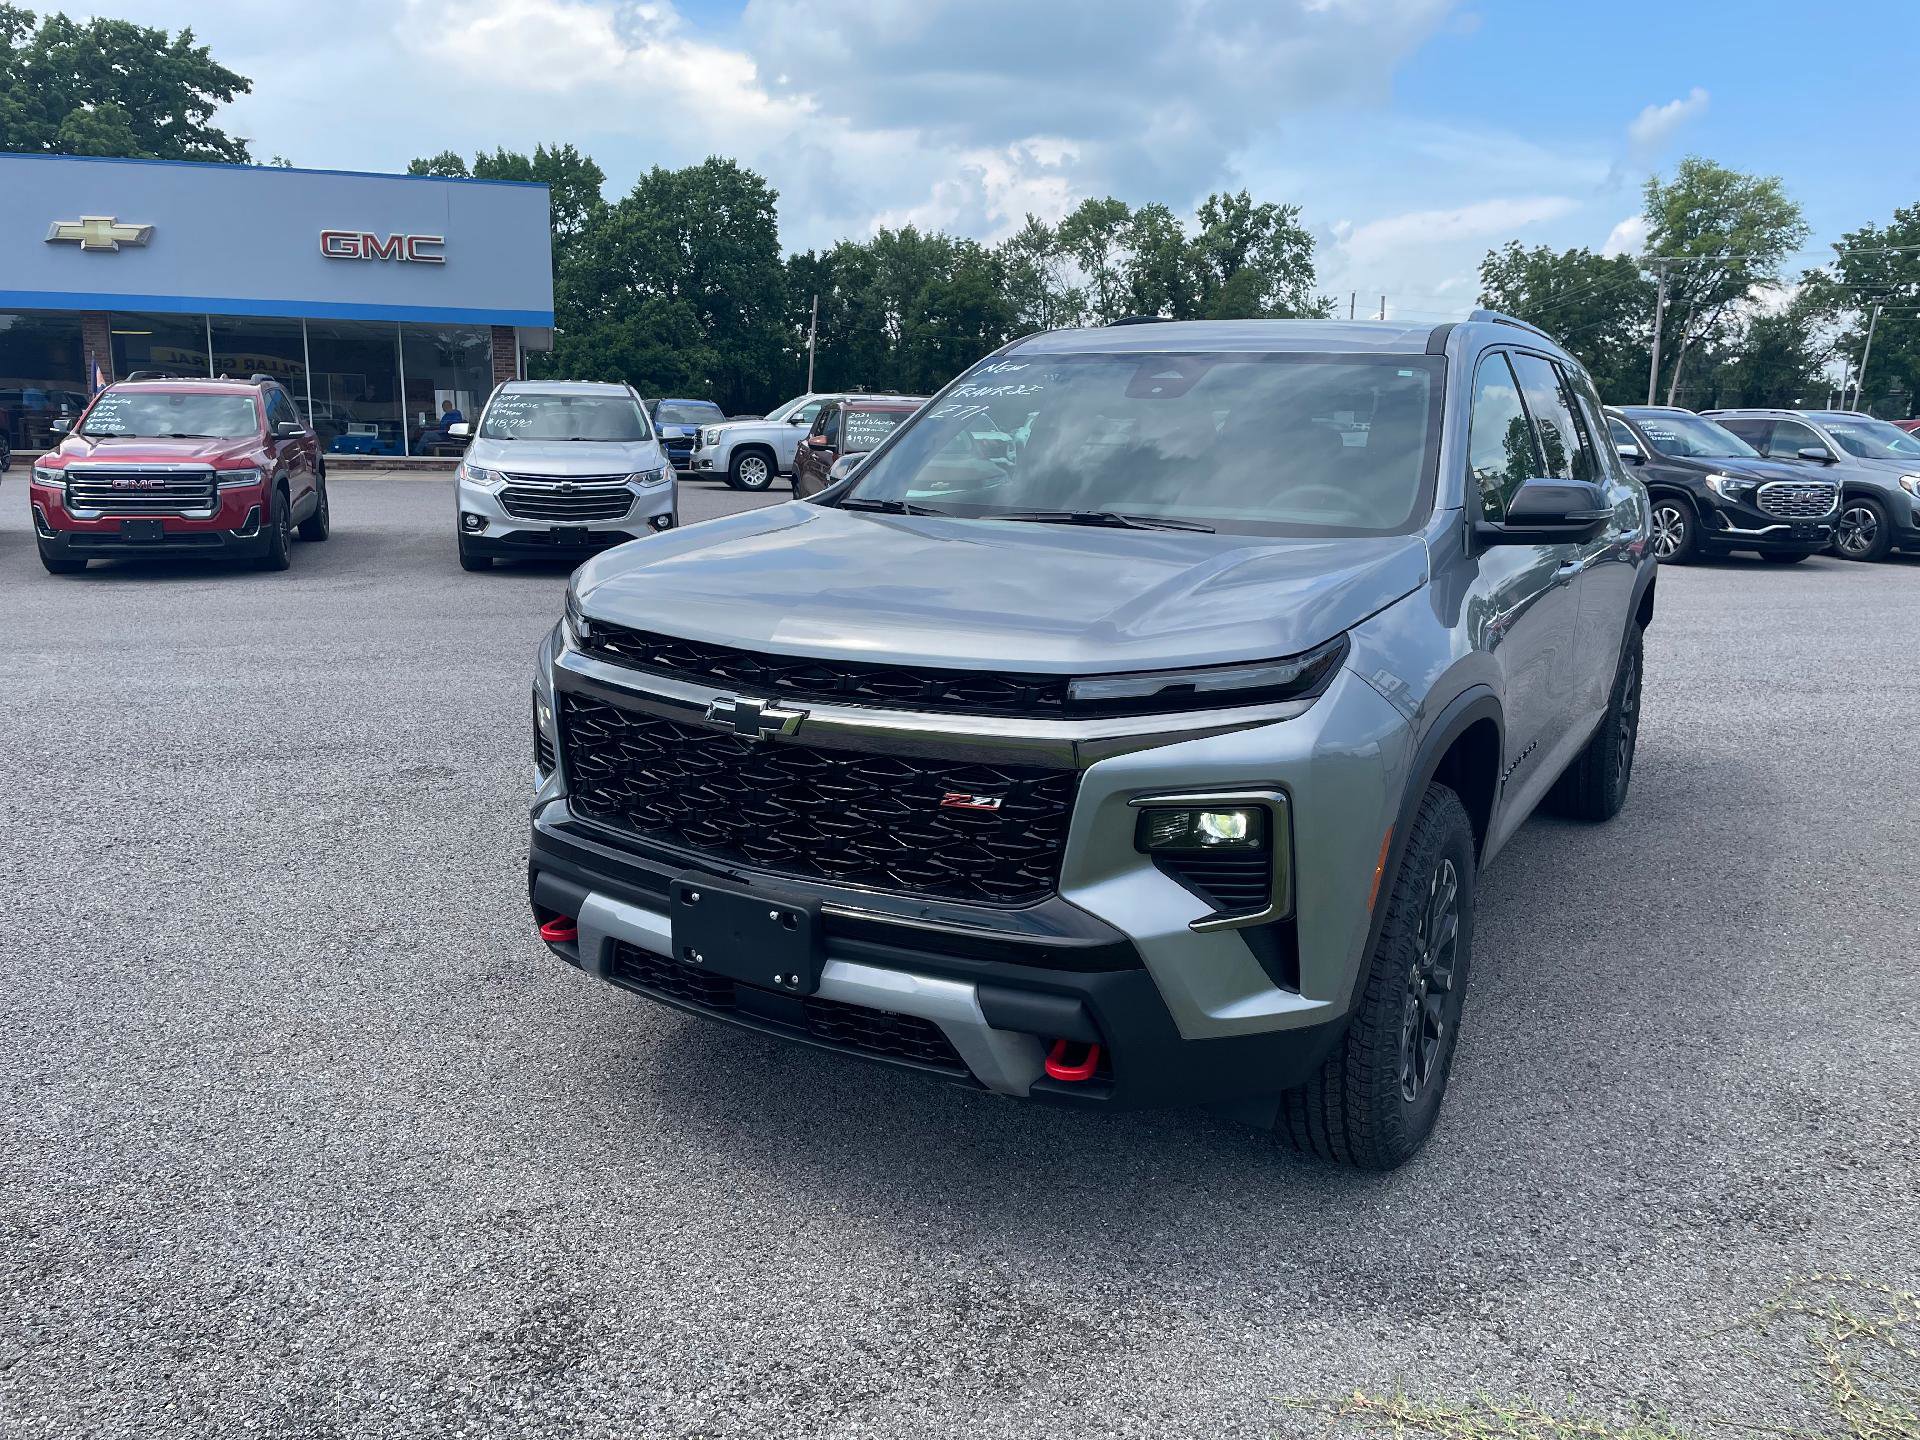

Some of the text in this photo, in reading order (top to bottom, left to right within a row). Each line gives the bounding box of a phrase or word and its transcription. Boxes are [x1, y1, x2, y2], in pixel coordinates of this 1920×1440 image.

[320, 230, 445, 262] GMC
[928, 404, 990, 420] Z71
[112, 479, 165, 489] GMC
[940, 792, 1003, 811] Z71
